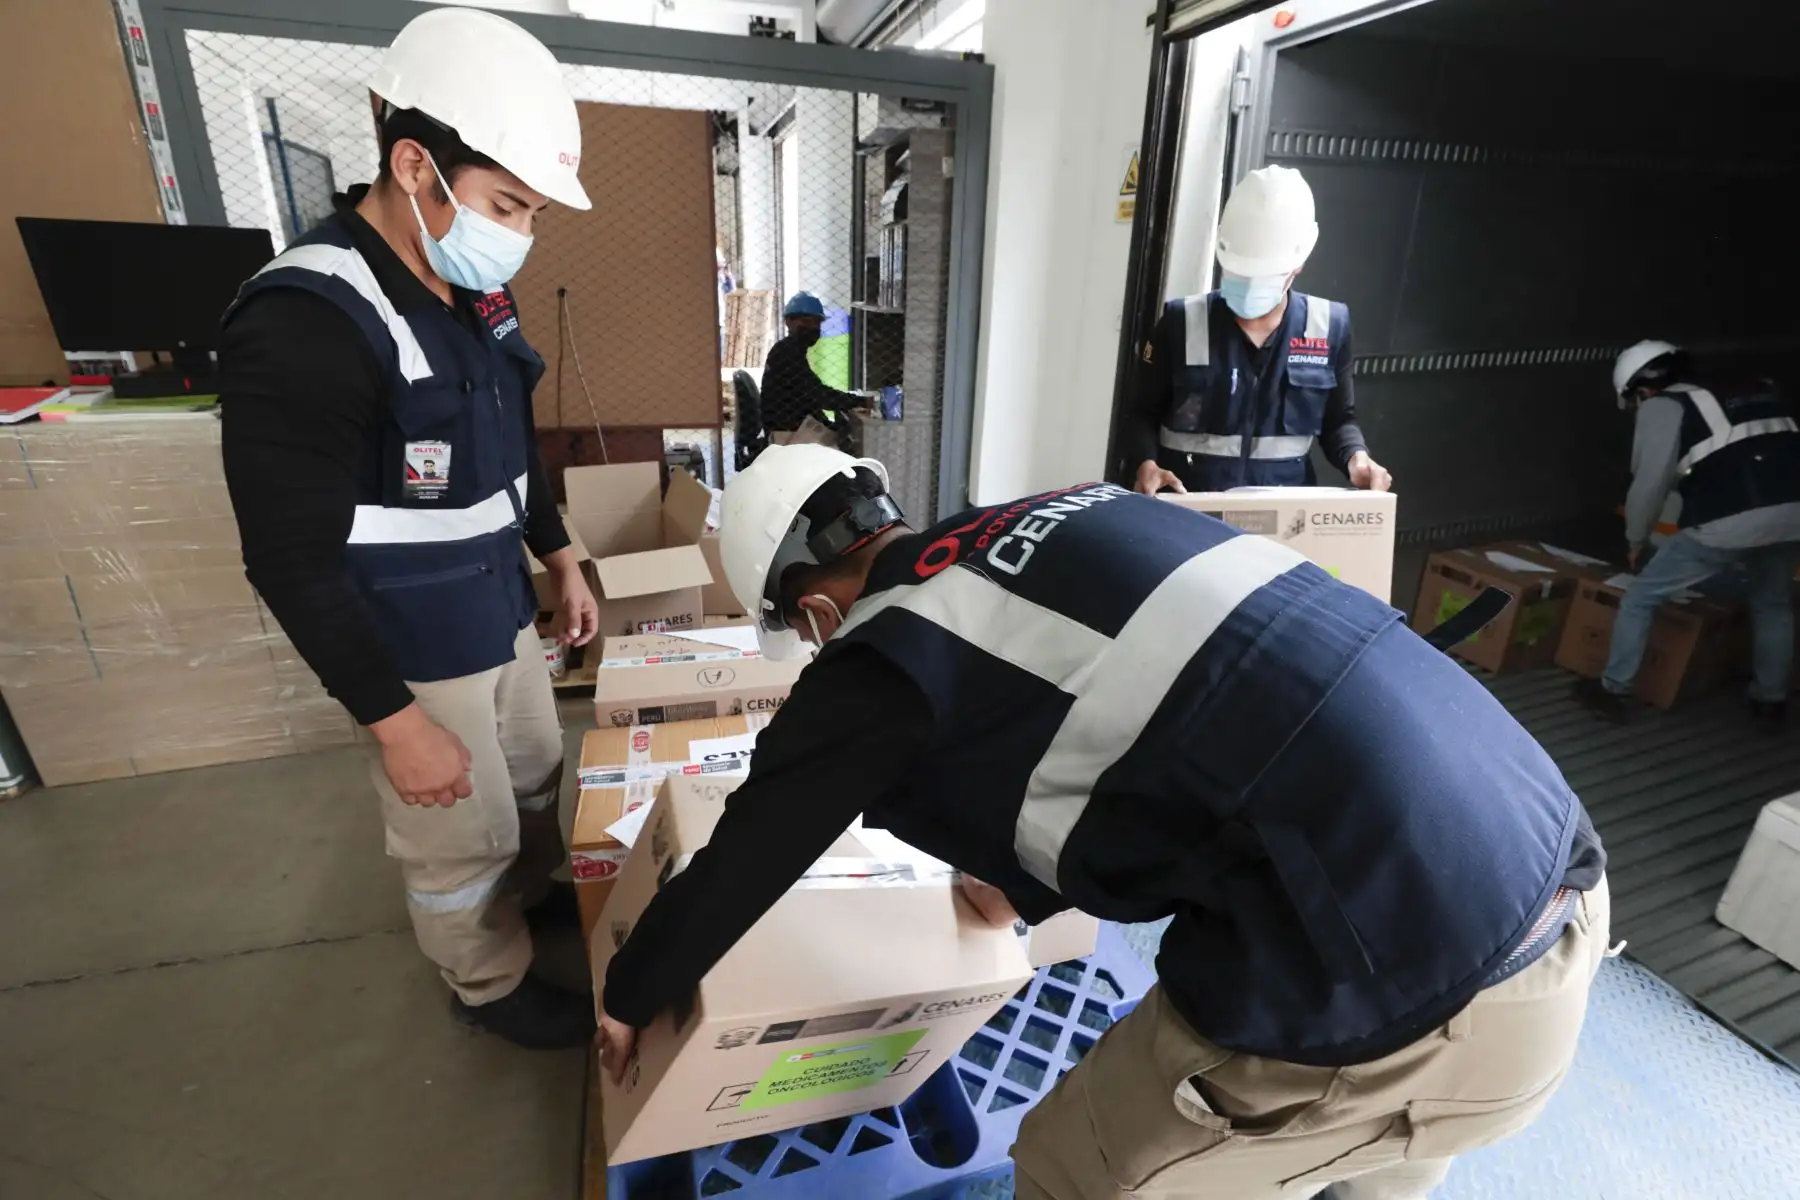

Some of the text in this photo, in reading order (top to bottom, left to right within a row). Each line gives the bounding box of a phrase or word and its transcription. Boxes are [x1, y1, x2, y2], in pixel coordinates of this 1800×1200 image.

[559, 152, 579, 168] OLIT
[1290, 337, 1329, 348] OLITEL
[1311, 512, 1384, 526] CENARES
[967, 502, 1030, 560] POYO
[987, 484, 1130, 576] CENAR
[637, 613, 693, 633] CENARES
[747, 695, 788, 711] CENA
[923, 991, 1008, 1013] CENARES
[768, 1060, 888, 1088] MEDICAMENTOS
[803, 1057, 871, 1075] CUIDADO
